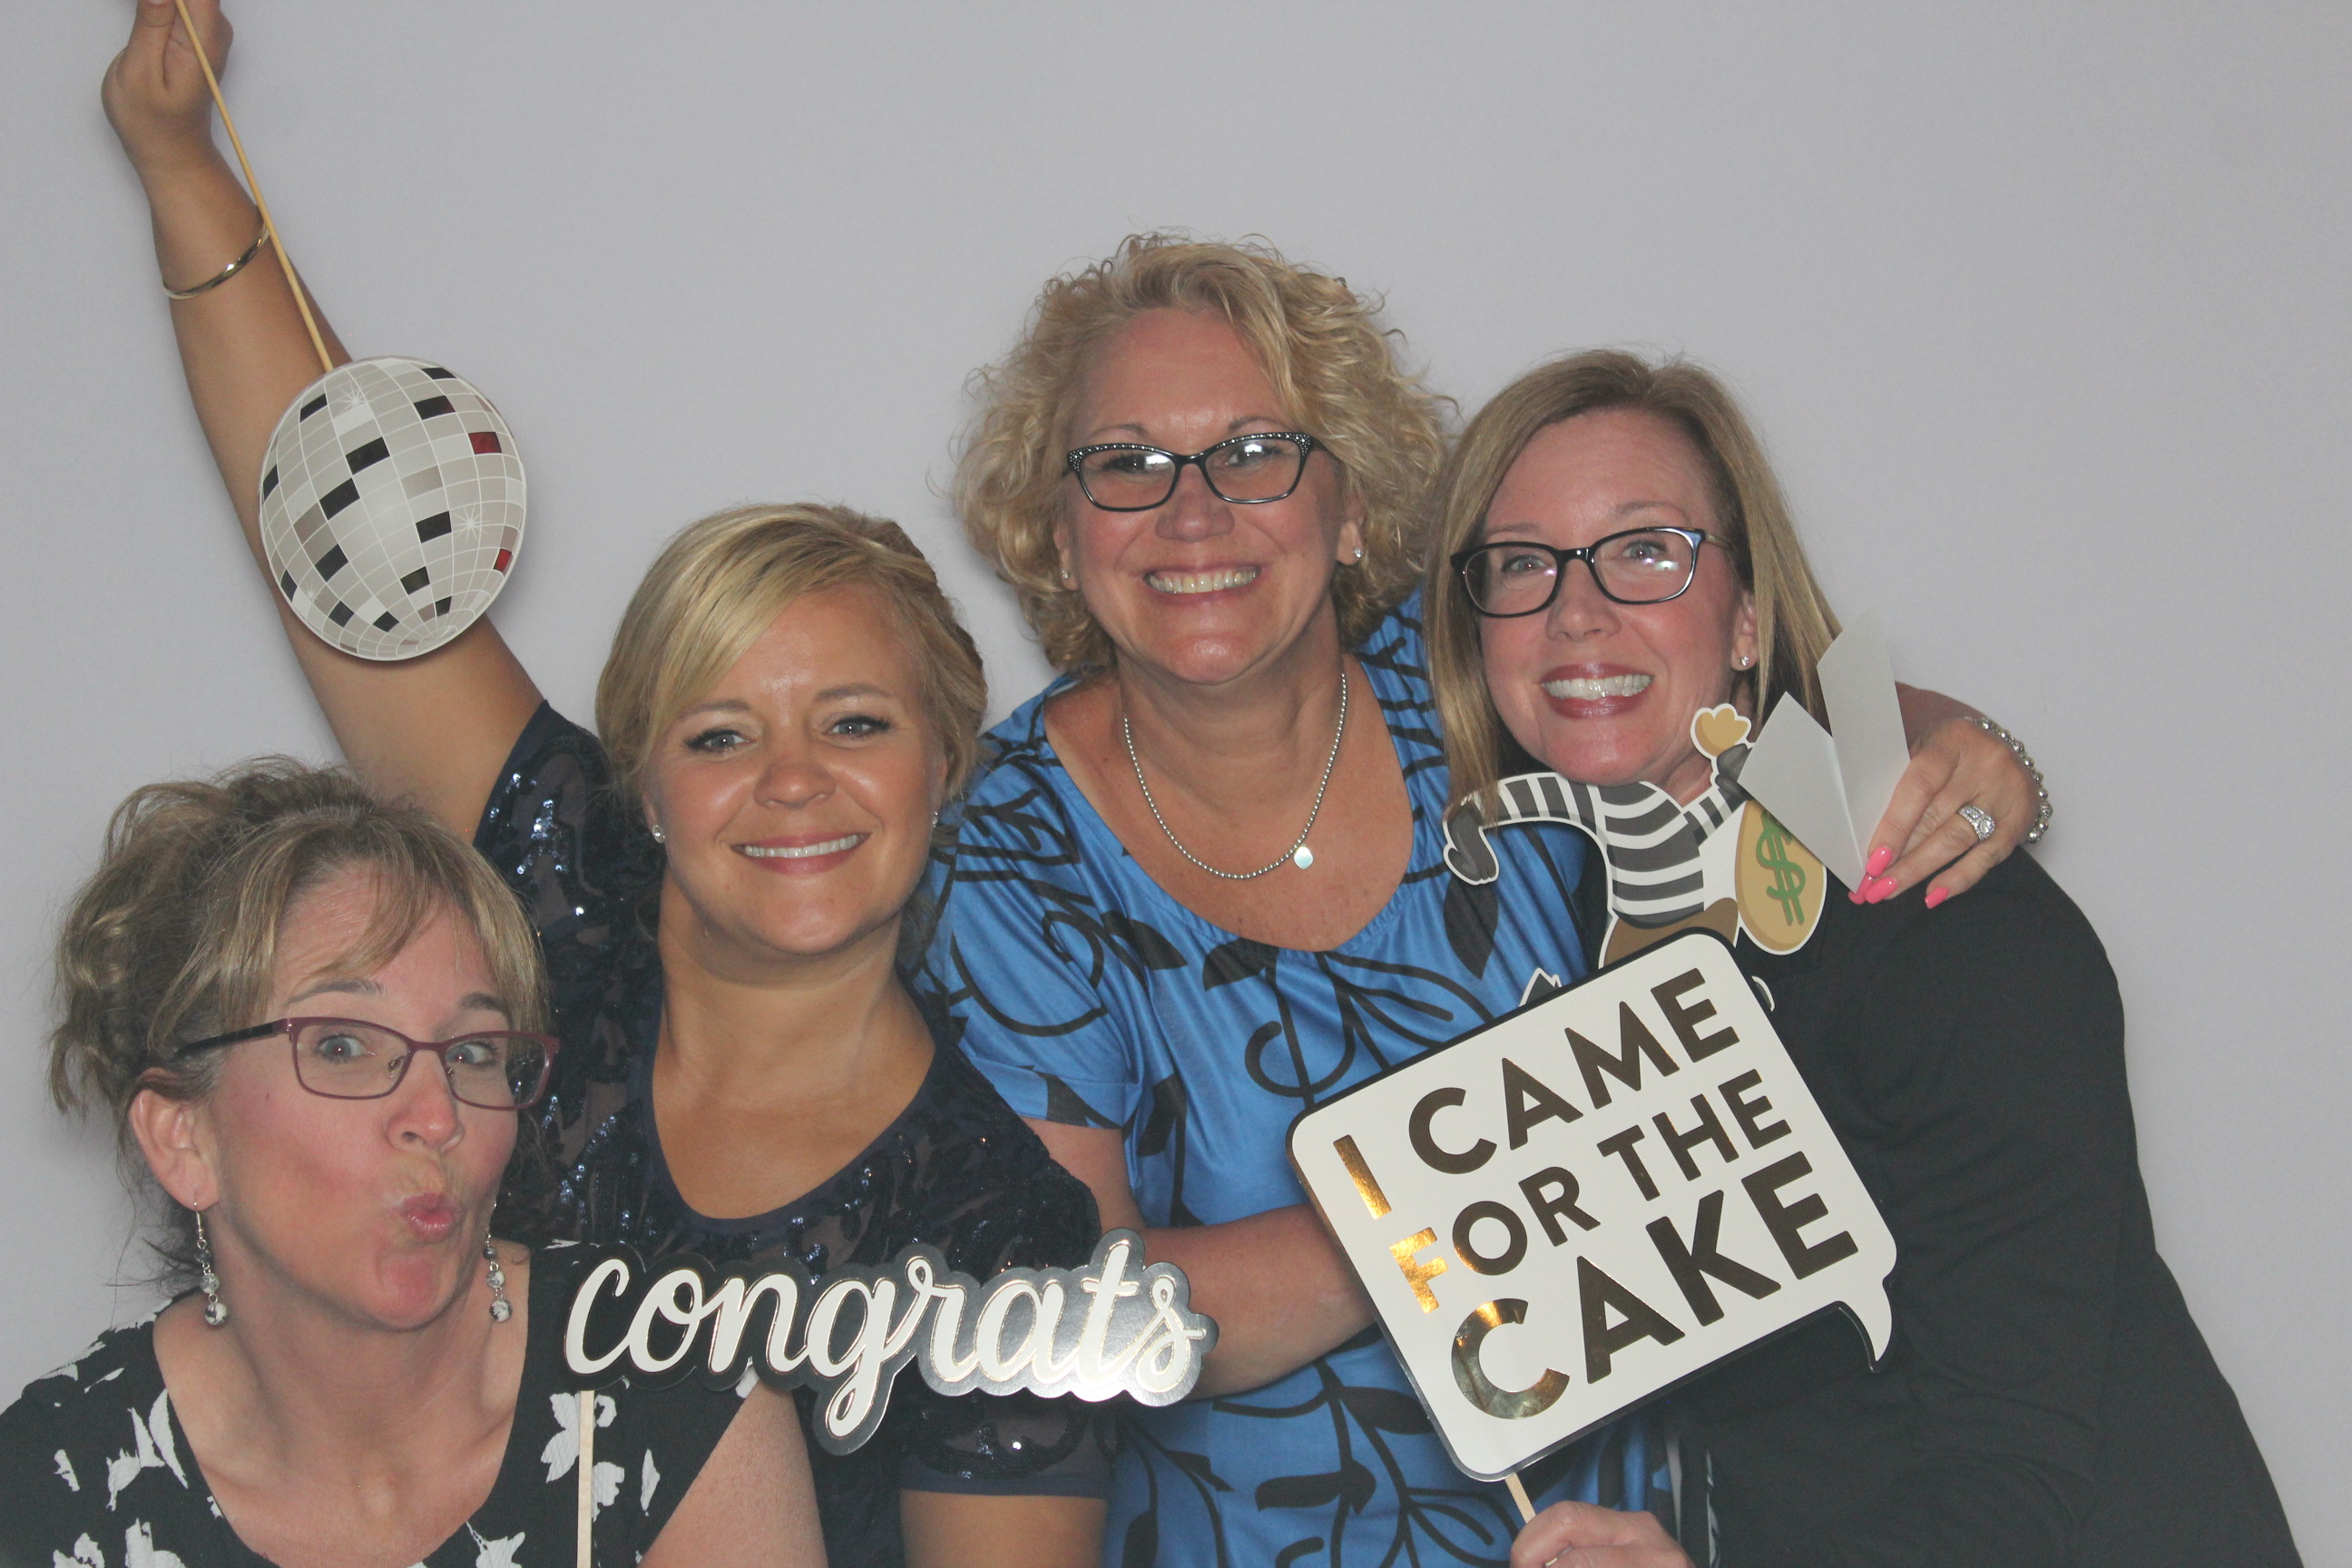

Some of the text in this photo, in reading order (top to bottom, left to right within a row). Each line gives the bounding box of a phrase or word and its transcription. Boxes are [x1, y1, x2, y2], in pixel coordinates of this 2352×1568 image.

[1333, 967, 1740, 1220] I CAME
[1389, 1068, 1792, 1314] FOR THE
[564, 1239, 1207, 1438] congrats
[1451, 1151, 1859, 1420] CAKE
